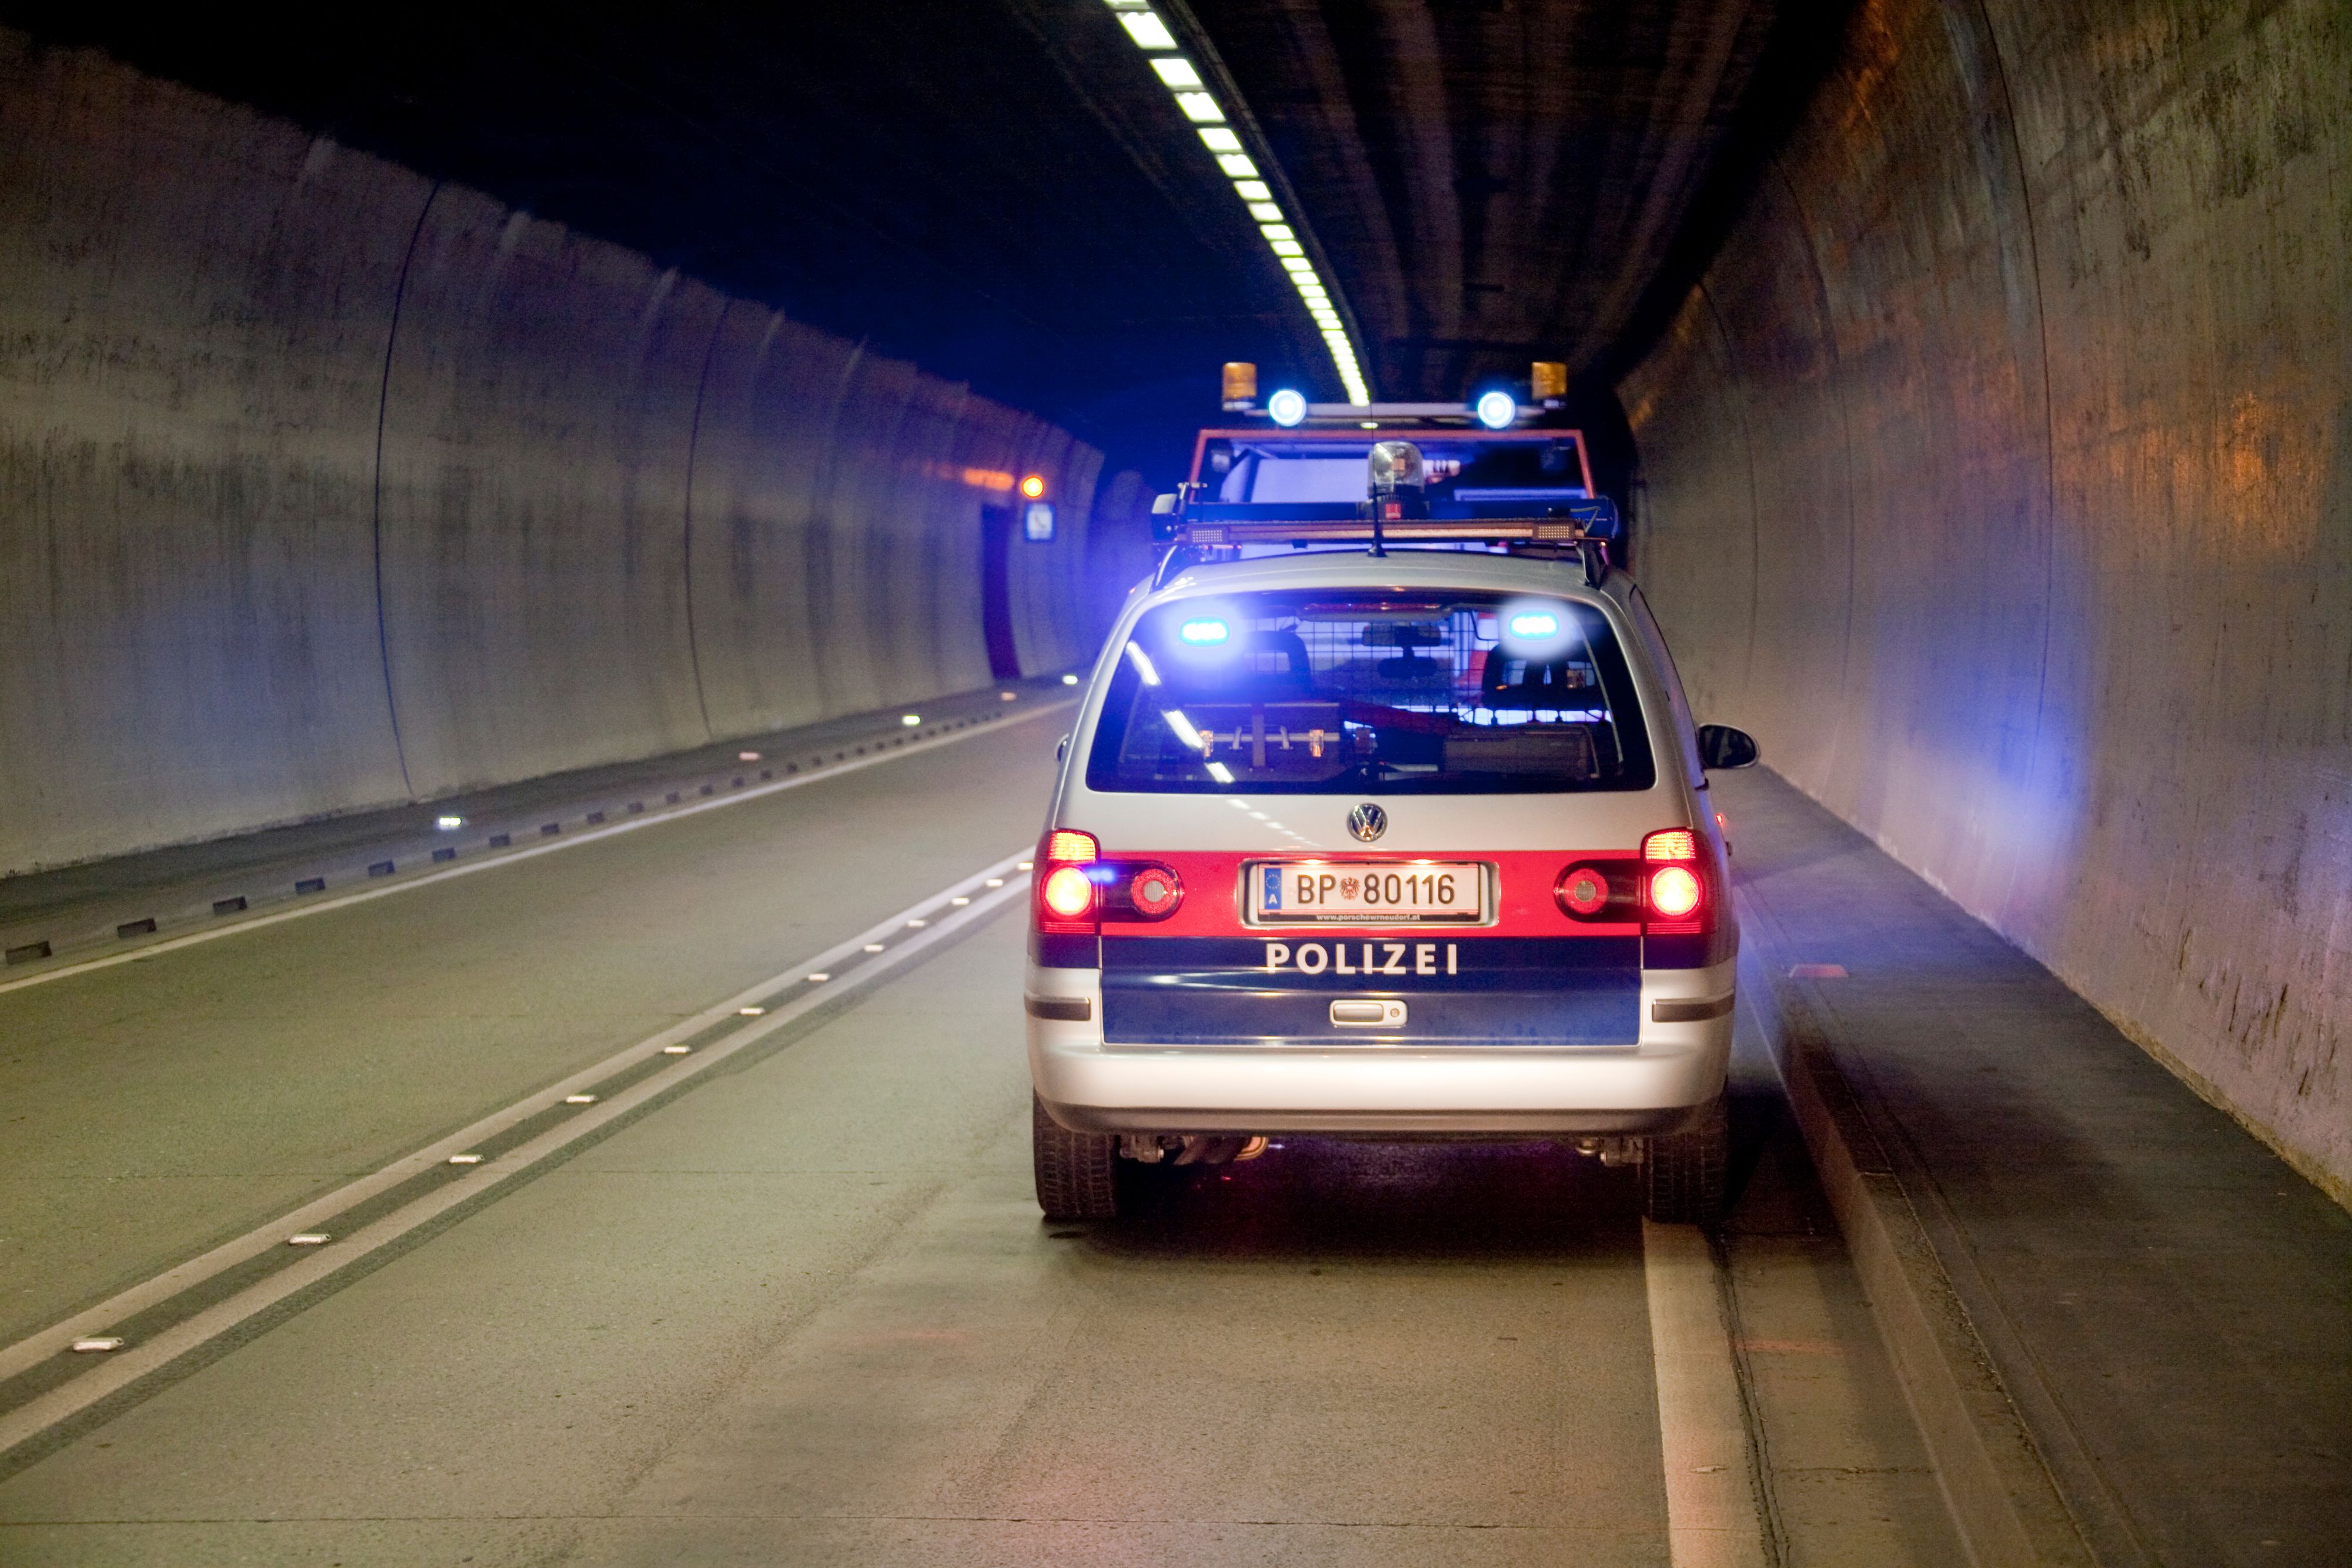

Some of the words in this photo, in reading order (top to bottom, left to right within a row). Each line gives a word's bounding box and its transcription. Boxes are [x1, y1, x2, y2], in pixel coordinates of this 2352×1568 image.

[1268, 893, 1278, 905] A
[1297, 874, 1337, 904] BP
[1364, 873, 1455, 904] 80116
[1316, 913, 1421, 922] www.porschewrneudorf.at
[1266, 943, 1457, 974] POLIZEI
